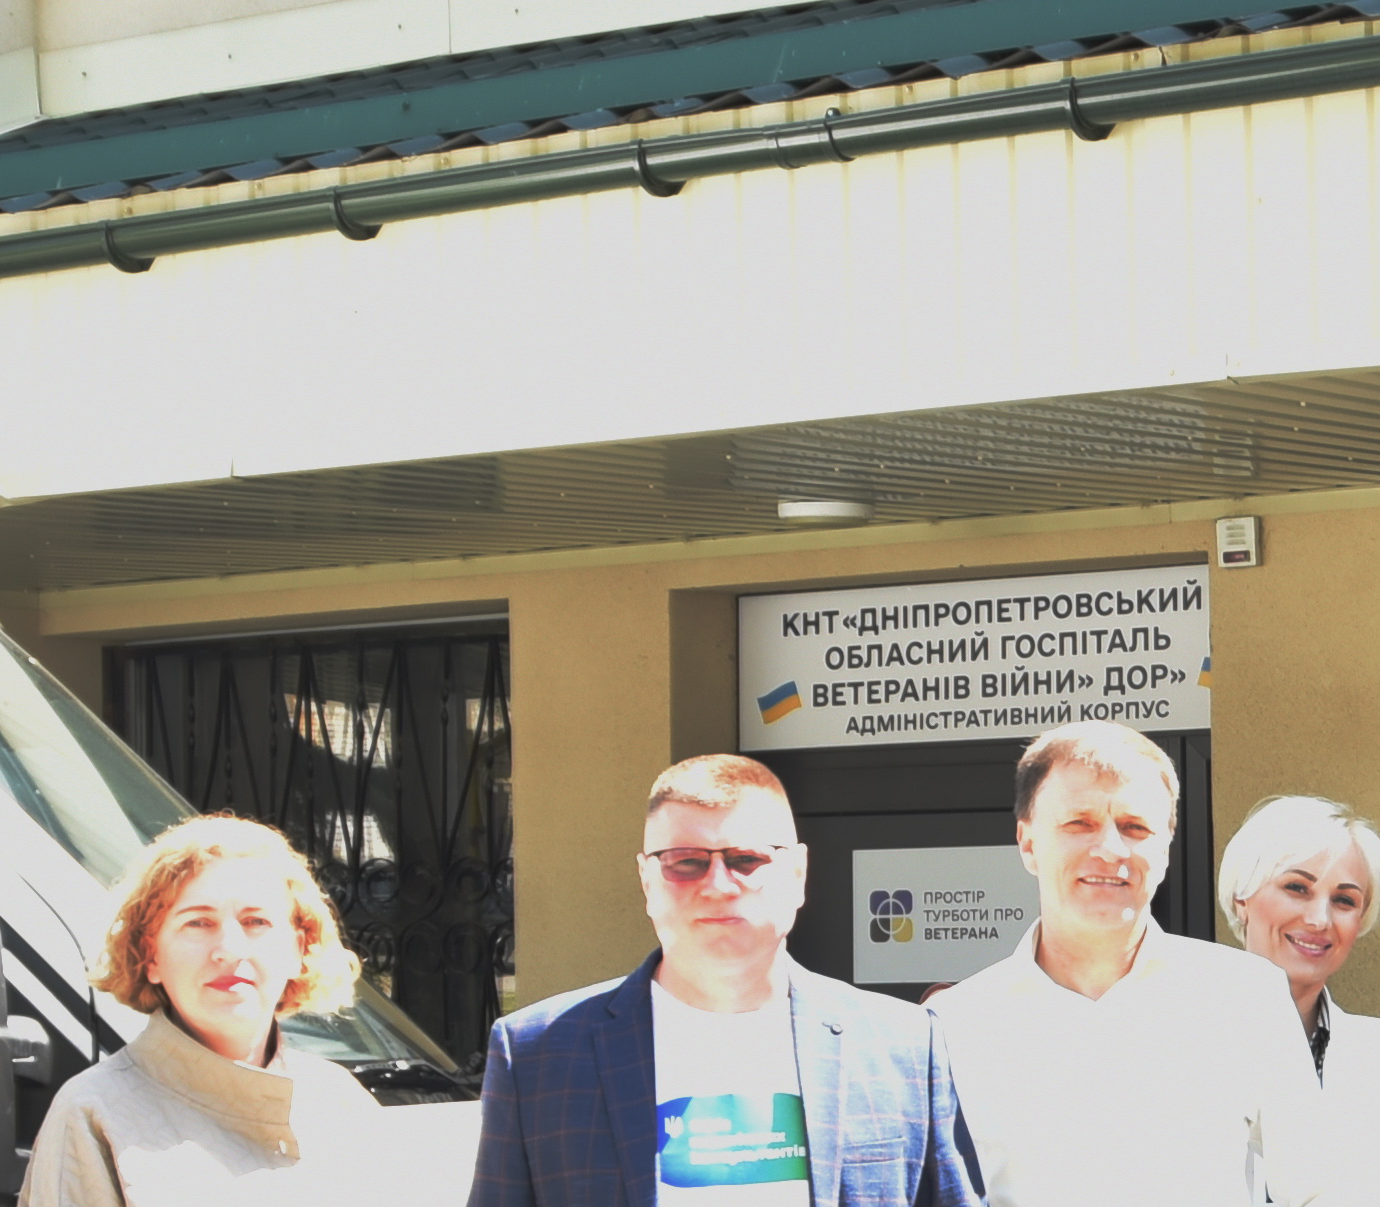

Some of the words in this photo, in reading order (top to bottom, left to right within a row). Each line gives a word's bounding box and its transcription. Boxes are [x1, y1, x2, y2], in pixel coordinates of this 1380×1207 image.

[824, 630, 989, 670] ОБЛАСНИЙ
[1000, 626, 1171, 660] ГОСПІТАЛЬ
[812, 675, 971, 708] ВЕТЕРАНІВ
[981, 665, 1094, 698] ВІЙНИ»
[1103, 664, 1186, 697] ДОР»
[845, 699, 1071, 736] АДМІНІСТРАТИВНИЙ
[1079, 699, 1170, 722] КОРПУС
[923, 890, 986, 905] ПРОСТІР
[923, 909, 989, 922] ТУРБОТИ
[994, 908, 1024, 921] ПРО
[924, 927, 999, 940] ВЕТЕРАНА
